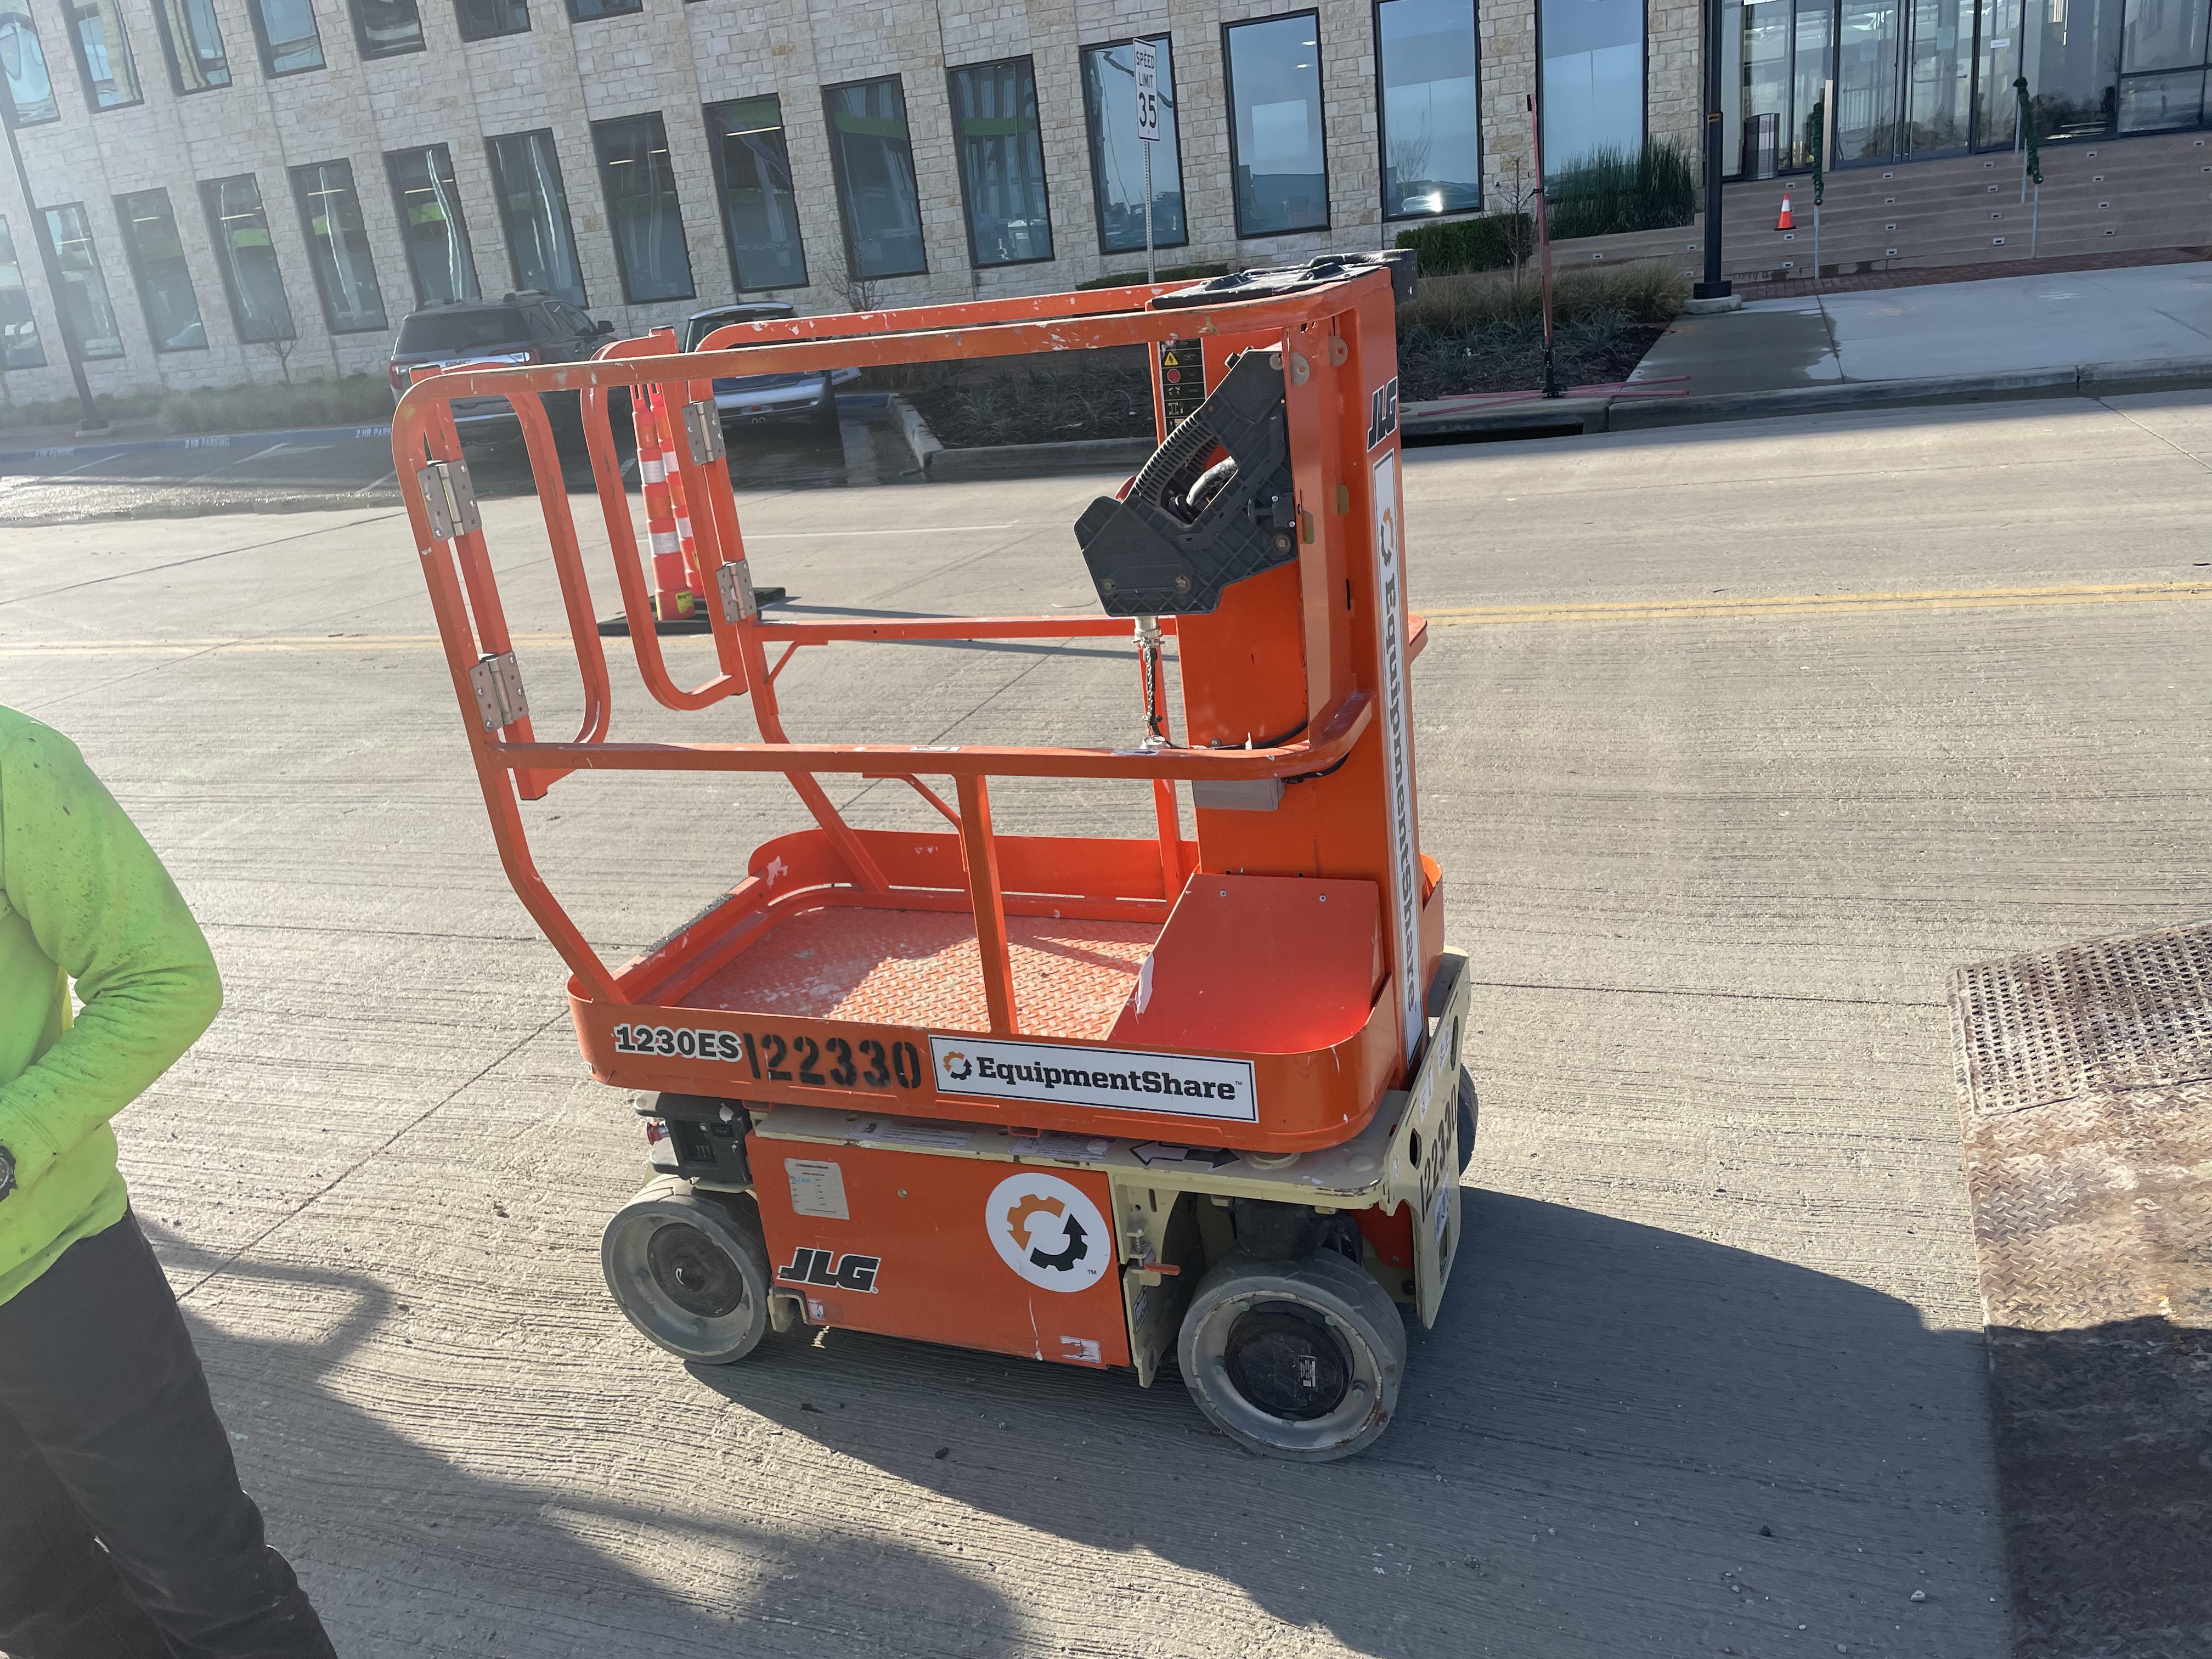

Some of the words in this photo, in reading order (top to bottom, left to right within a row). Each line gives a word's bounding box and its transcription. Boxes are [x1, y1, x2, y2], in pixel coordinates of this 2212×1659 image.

[1136, 50, 1155, 69] SPEED
[1138, 72, 1153, 89] LIMIT
[1138, 92, 1156, 129] 35
[356, 429, 360, 438] 2
[362, 428, 371, 437] HR
[374, 427, 392, 437] PARK
[1367, 376, 1398, 453] JLG
[184, 439, 189, 449] 2
[1385, 573, 1414, 1012] EquipmentShare
[615, 1024, 742, 1061] 1230ES
[743, 1032, 921, 1089] 122330
[977, 1056, 1235, 1100] EquipmentShare
[776, 1246, 882, 1293] JLG
